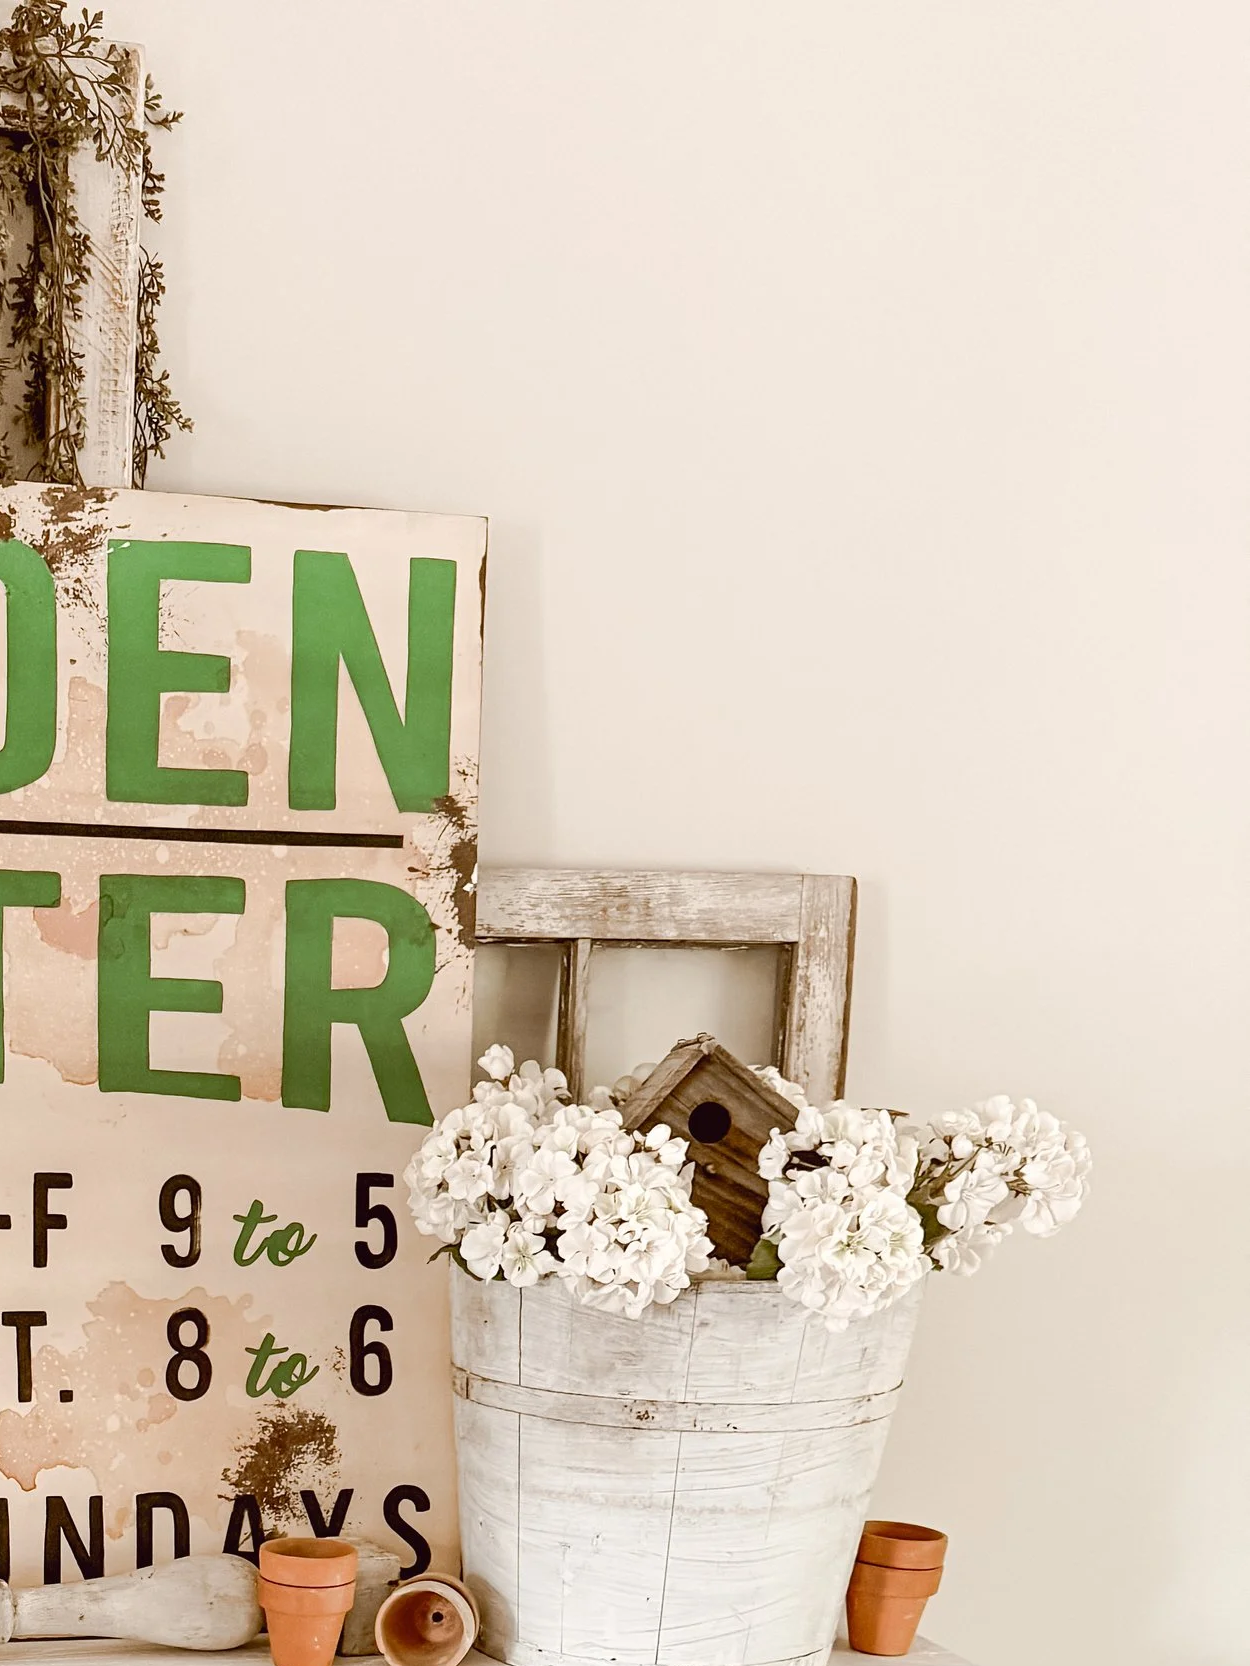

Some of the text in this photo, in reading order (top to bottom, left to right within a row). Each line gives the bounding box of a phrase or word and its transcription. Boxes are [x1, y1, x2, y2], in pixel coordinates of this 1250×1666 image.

[158, 1174, 202, 1268] 9
[232, 1199, 318, 1268] to
[353, 1172, 398, 1269] 5
[165, 1307, 212, 1402] 8
[244, 1332, 320, 1399] to
[349, 1304, 394, 1397] 6
